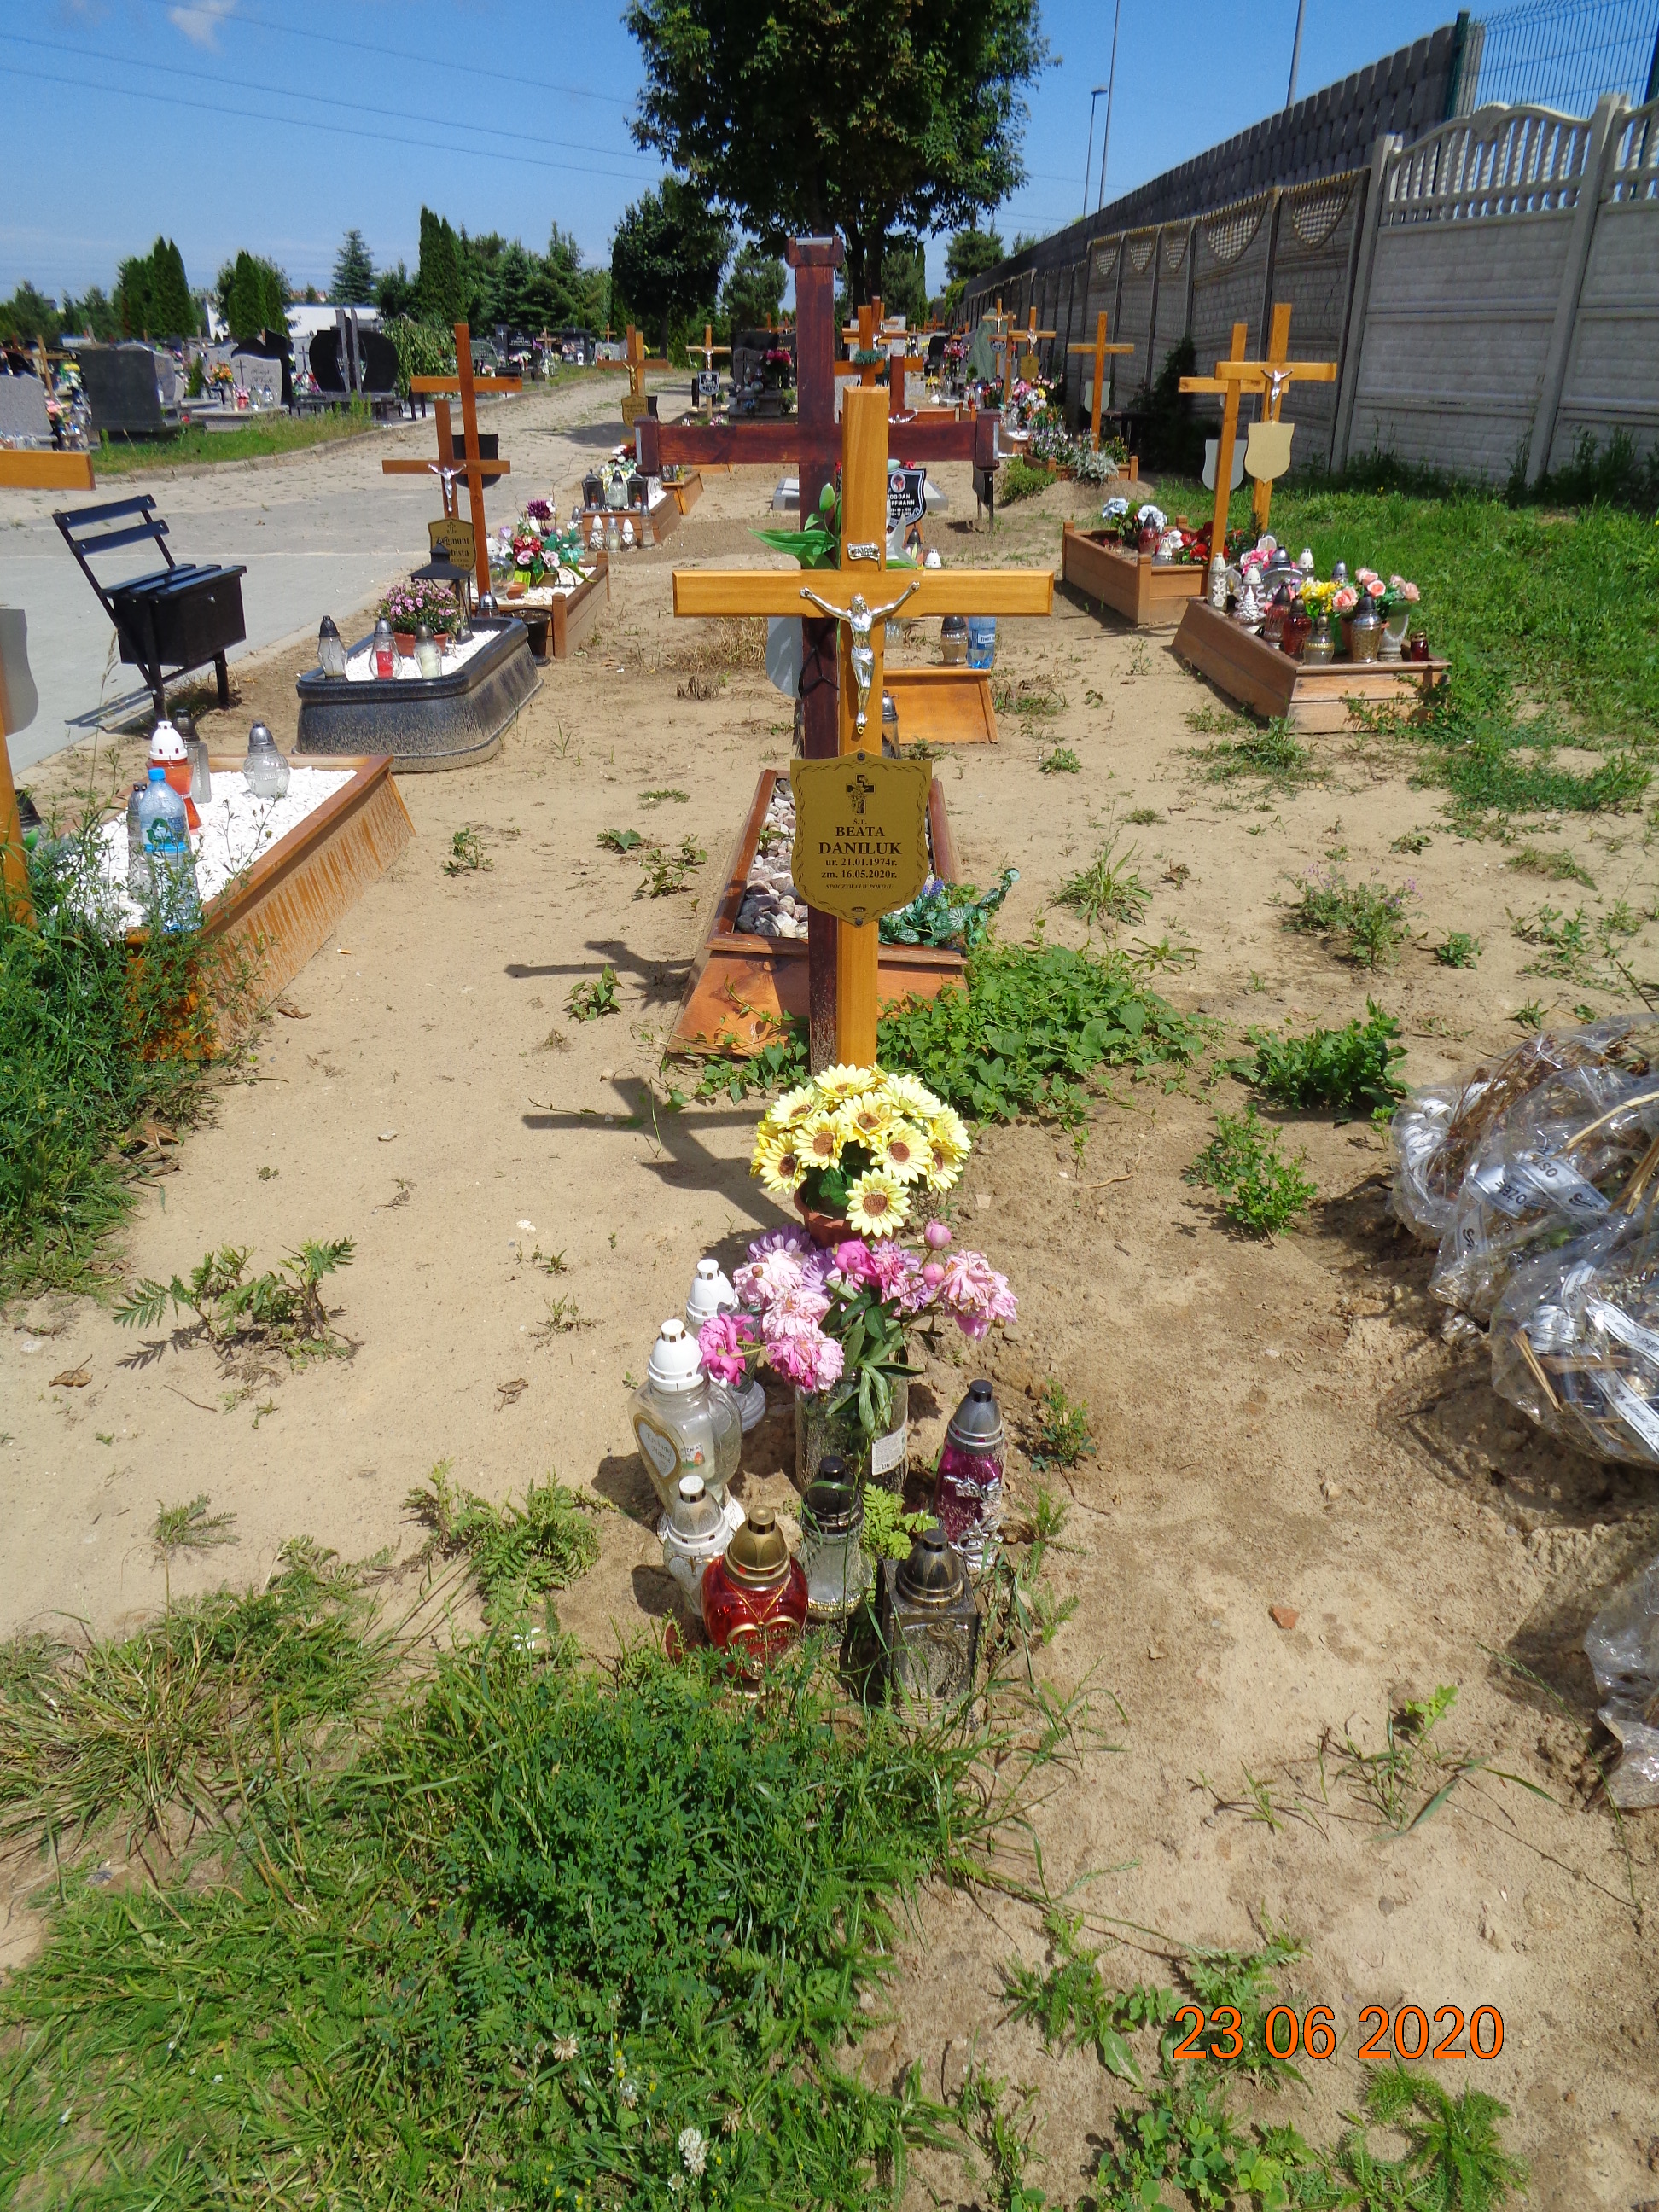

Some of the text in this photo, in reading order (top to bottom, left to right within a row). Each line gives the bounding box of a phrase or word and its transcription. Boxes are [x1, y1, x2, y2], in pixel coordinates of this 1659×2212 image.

[835, 826, 885, 837] BEATA
[818, 842, 903, 854] DANILUK
[841, 858, 898, 866] 21.01.1974r.
[841, 870, 897, 879] 16.05.2020r.
